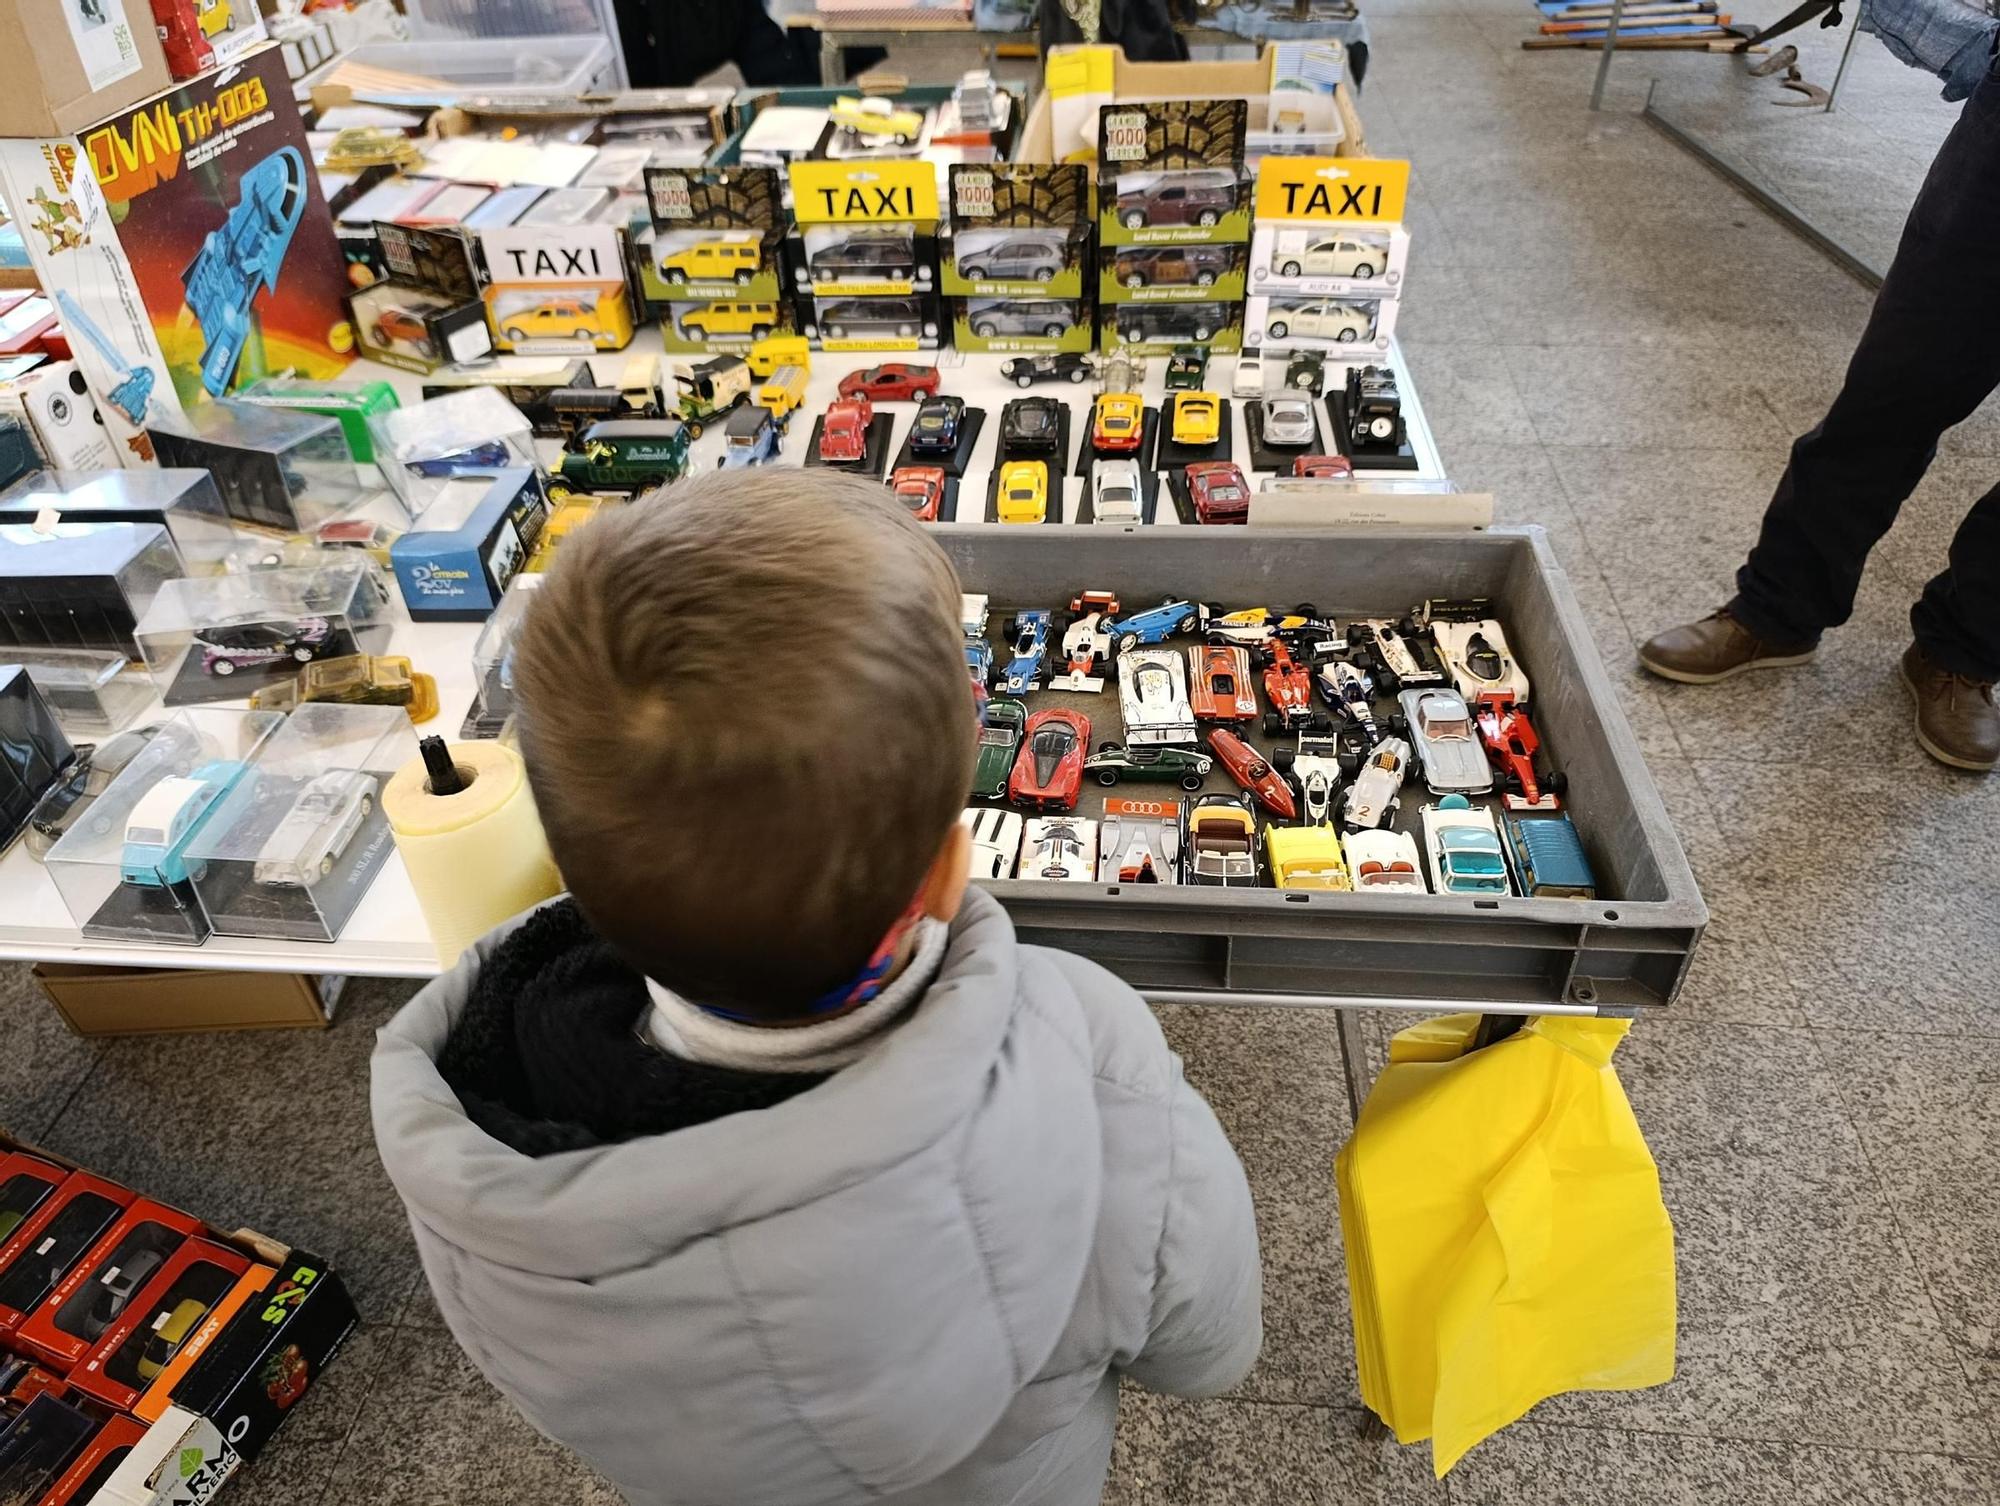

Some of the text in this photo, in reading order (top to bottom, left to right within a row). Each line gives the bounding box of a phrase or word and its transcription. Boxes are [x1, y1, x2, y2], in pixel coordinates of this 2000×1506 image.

[85, 101, 183, 186] OVNI
[1108, 128, 1146, 146] TODO
[818, 187, 914, 217] TAXI
[957, 186, 993, 203] TODO
[1281, 183, 1383, 216] TAXI
[506, 248, 602, 277] TAXI
[1012, 679, 1020, 687] 4
[1301, 736, 1334, 744] parmalat
[1200, 760, 1209, 774] 12
[1264, 785, 1276, 799] 2
[1358, 805, 1370, 817] 2
[61, 1262, 91, 1294] SEAT
[98, 1326, 126, 1360] SEAT
[185, 1317, 220, 1358] SEAT
